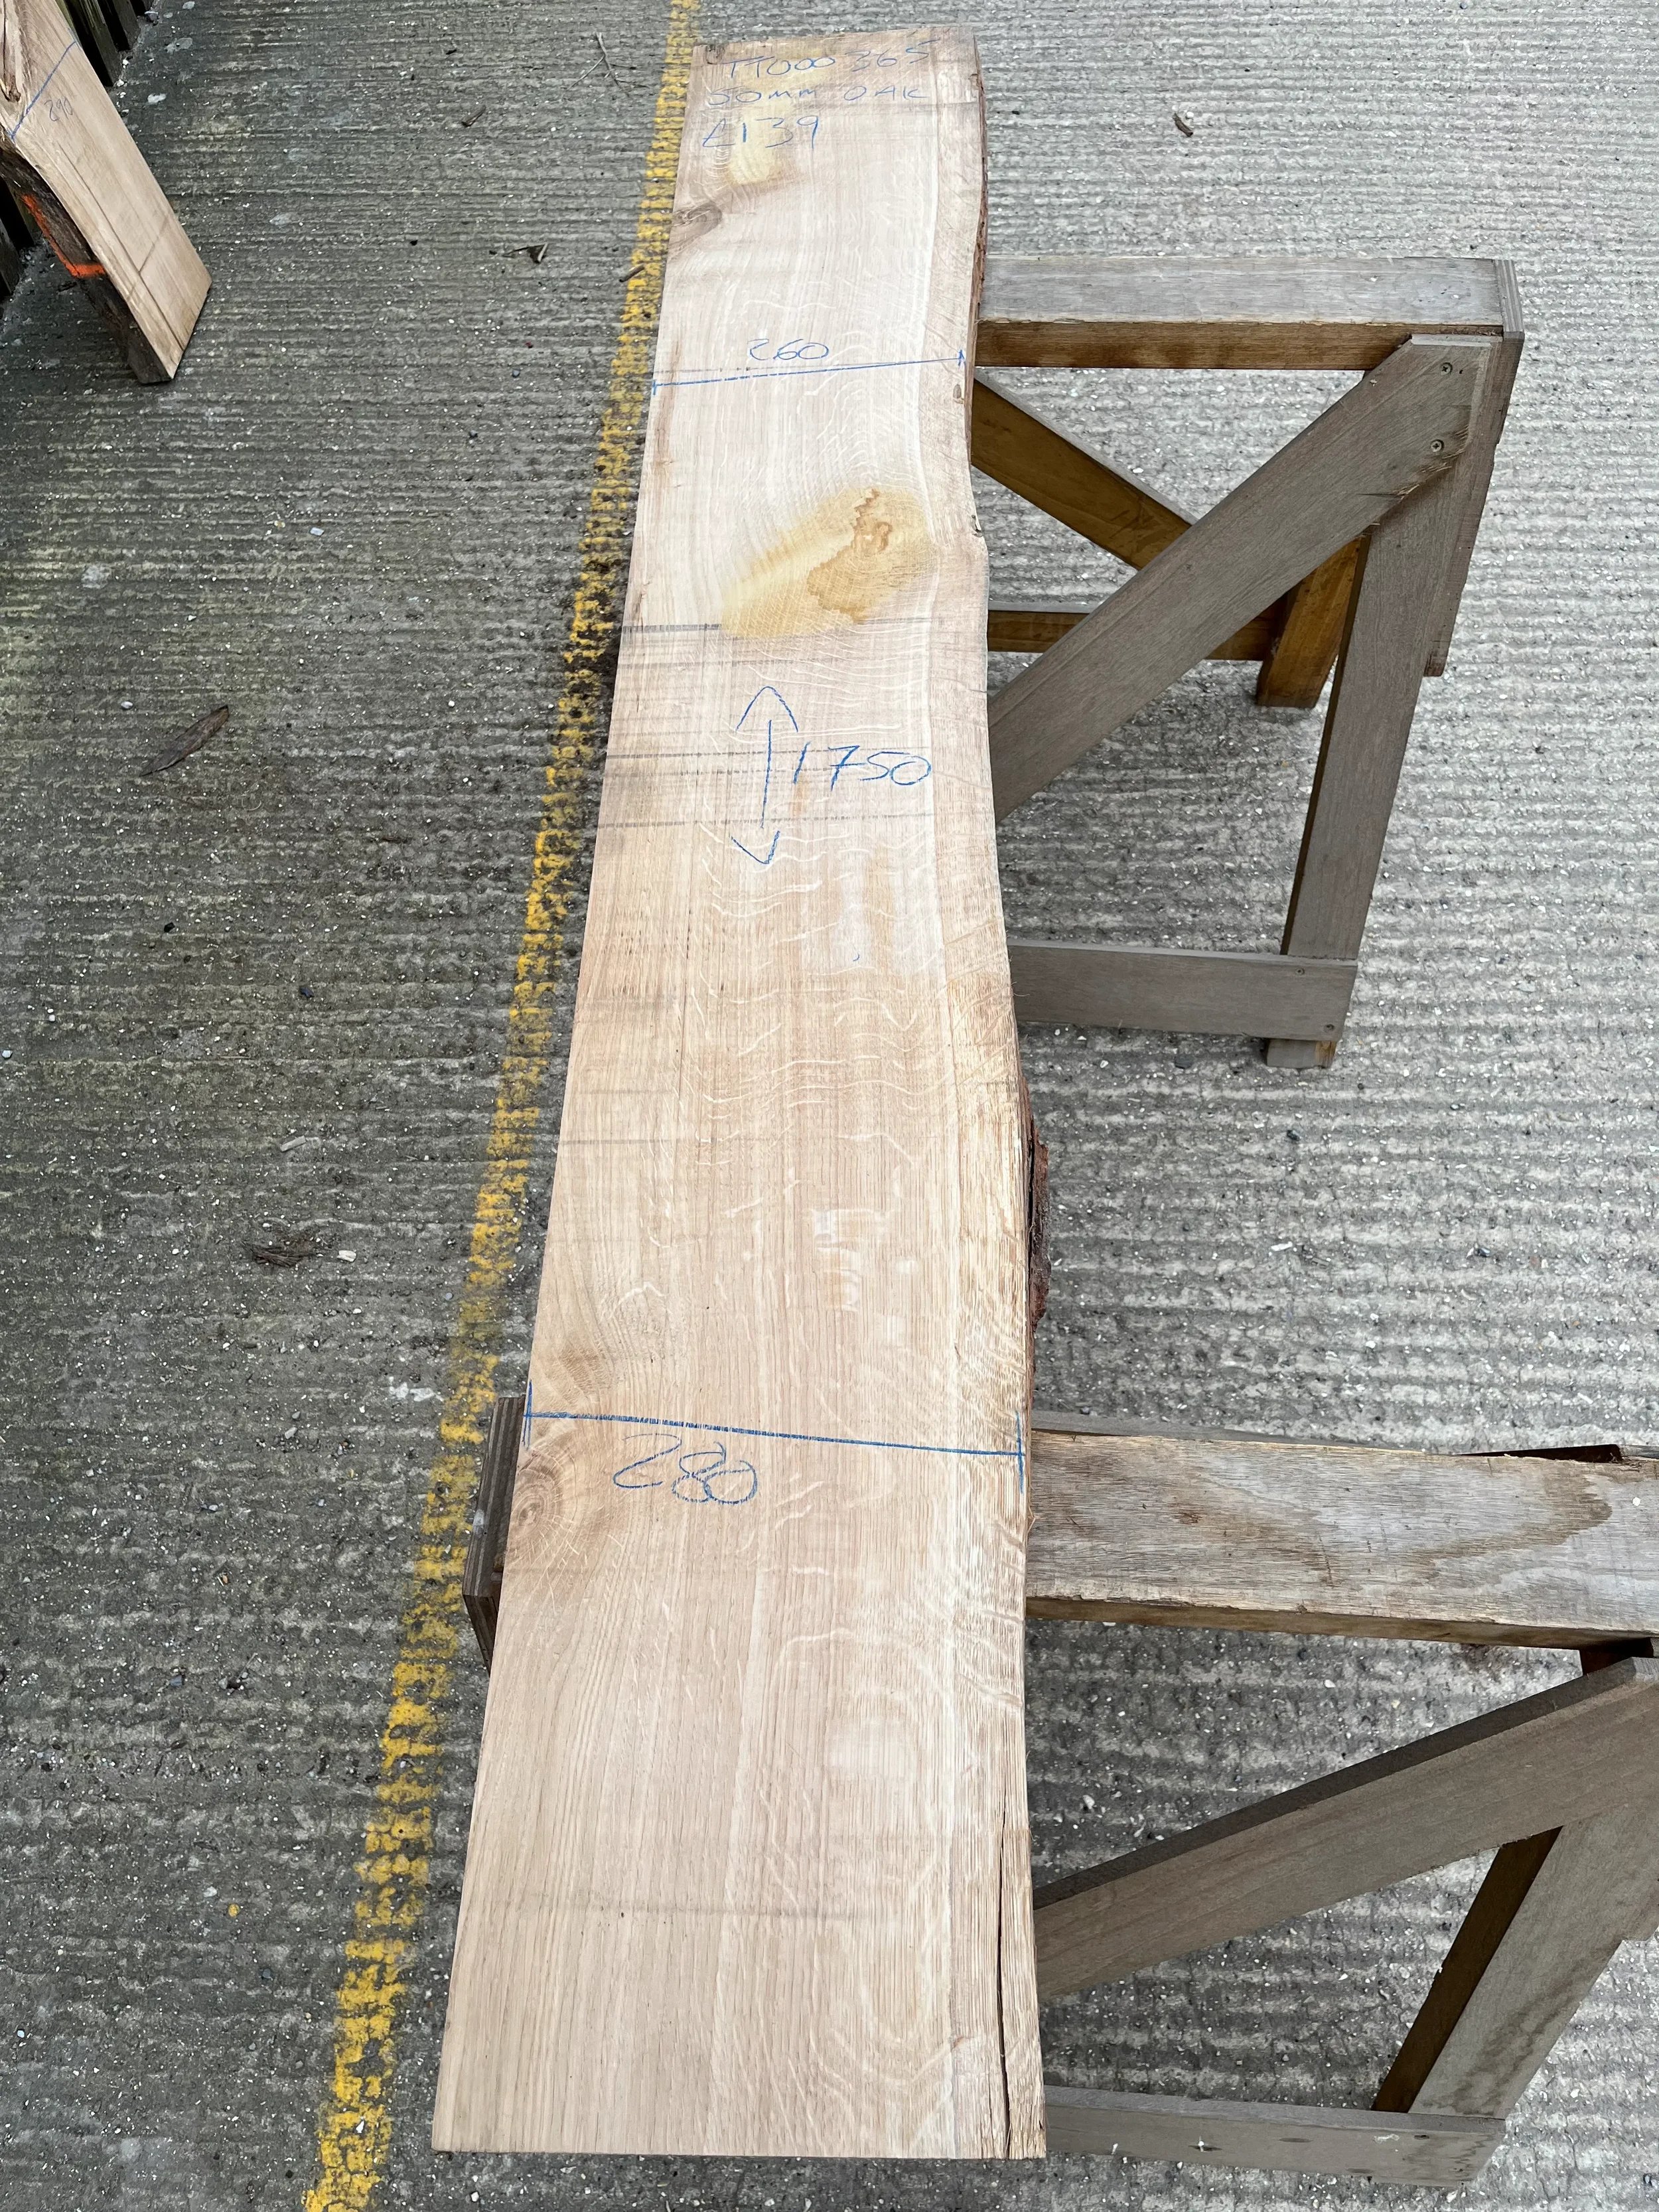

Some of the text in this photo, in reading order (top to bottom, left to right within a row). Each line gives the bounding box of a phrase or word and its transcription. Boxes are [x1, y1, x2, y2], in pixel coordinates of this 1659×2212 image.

[843, 85, 929, 102] OAK
[44, 96, 73, 121] 290
[703, 115, 820, 149] £139
[748, 338, 830, 362] 260
[792, 741, 932, 792] 1750
[613, 1432, 758, 1504] 280
